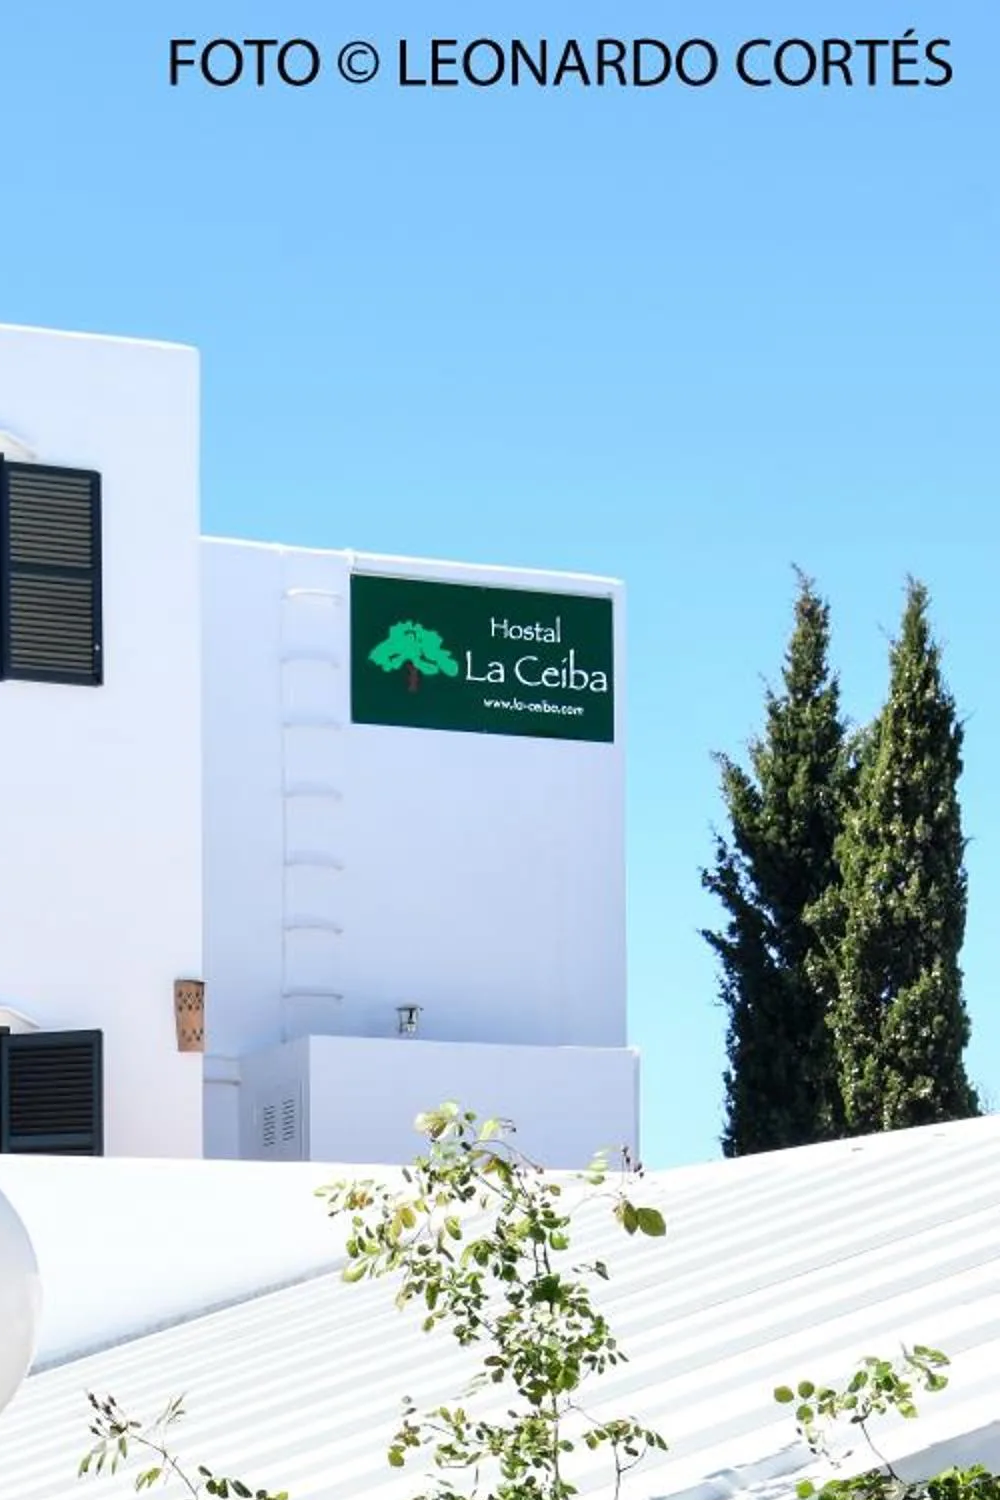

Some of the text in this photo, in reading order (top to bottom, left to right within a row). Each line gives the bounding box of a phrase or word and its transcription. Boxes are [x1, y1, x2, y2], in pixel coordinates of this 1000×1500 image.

[490, 616, 561, 643] Hostal
[465, 648, 608, 692] La Ceiba
